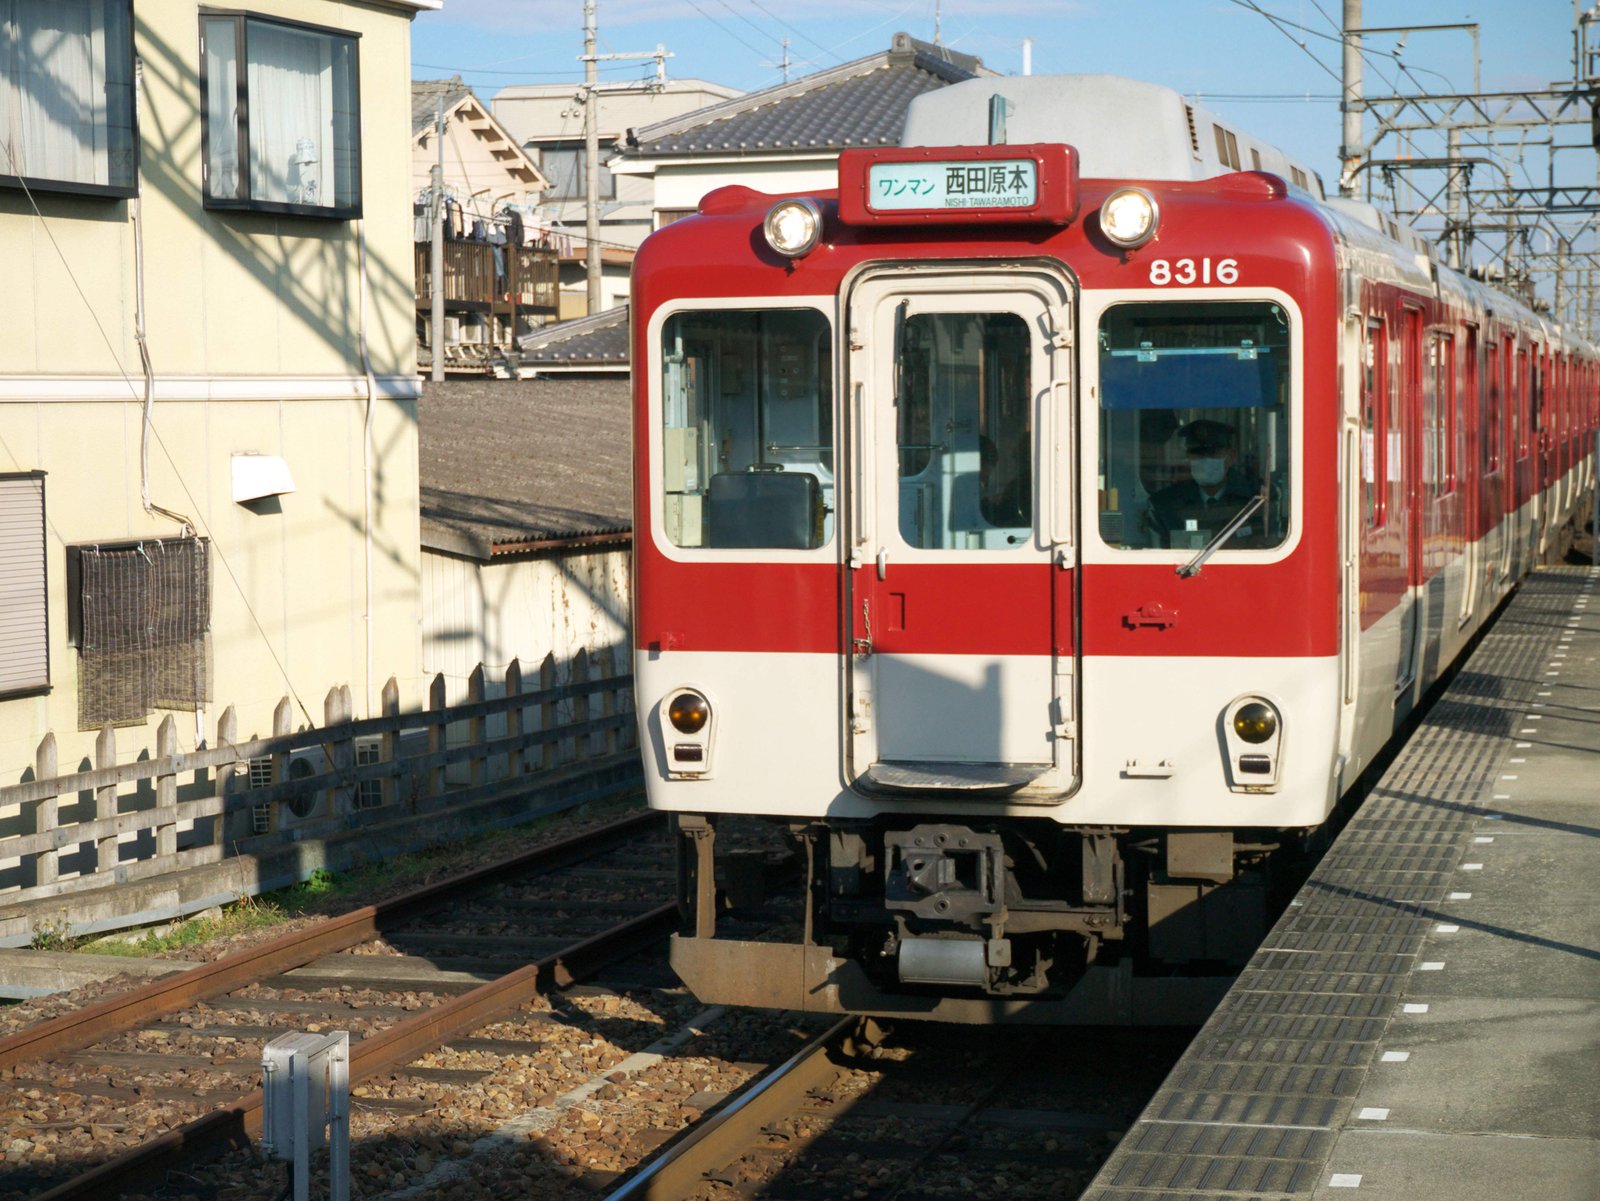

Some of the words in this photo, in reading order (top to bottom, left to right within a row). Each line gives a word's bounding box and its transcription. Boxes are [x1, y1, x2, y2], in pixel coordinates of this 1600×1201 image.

[879, 178, 936, 197] ワンマン
[945, 164, 1028, 195] 西田原本
[1149, 257, 1239, 286] 8316
